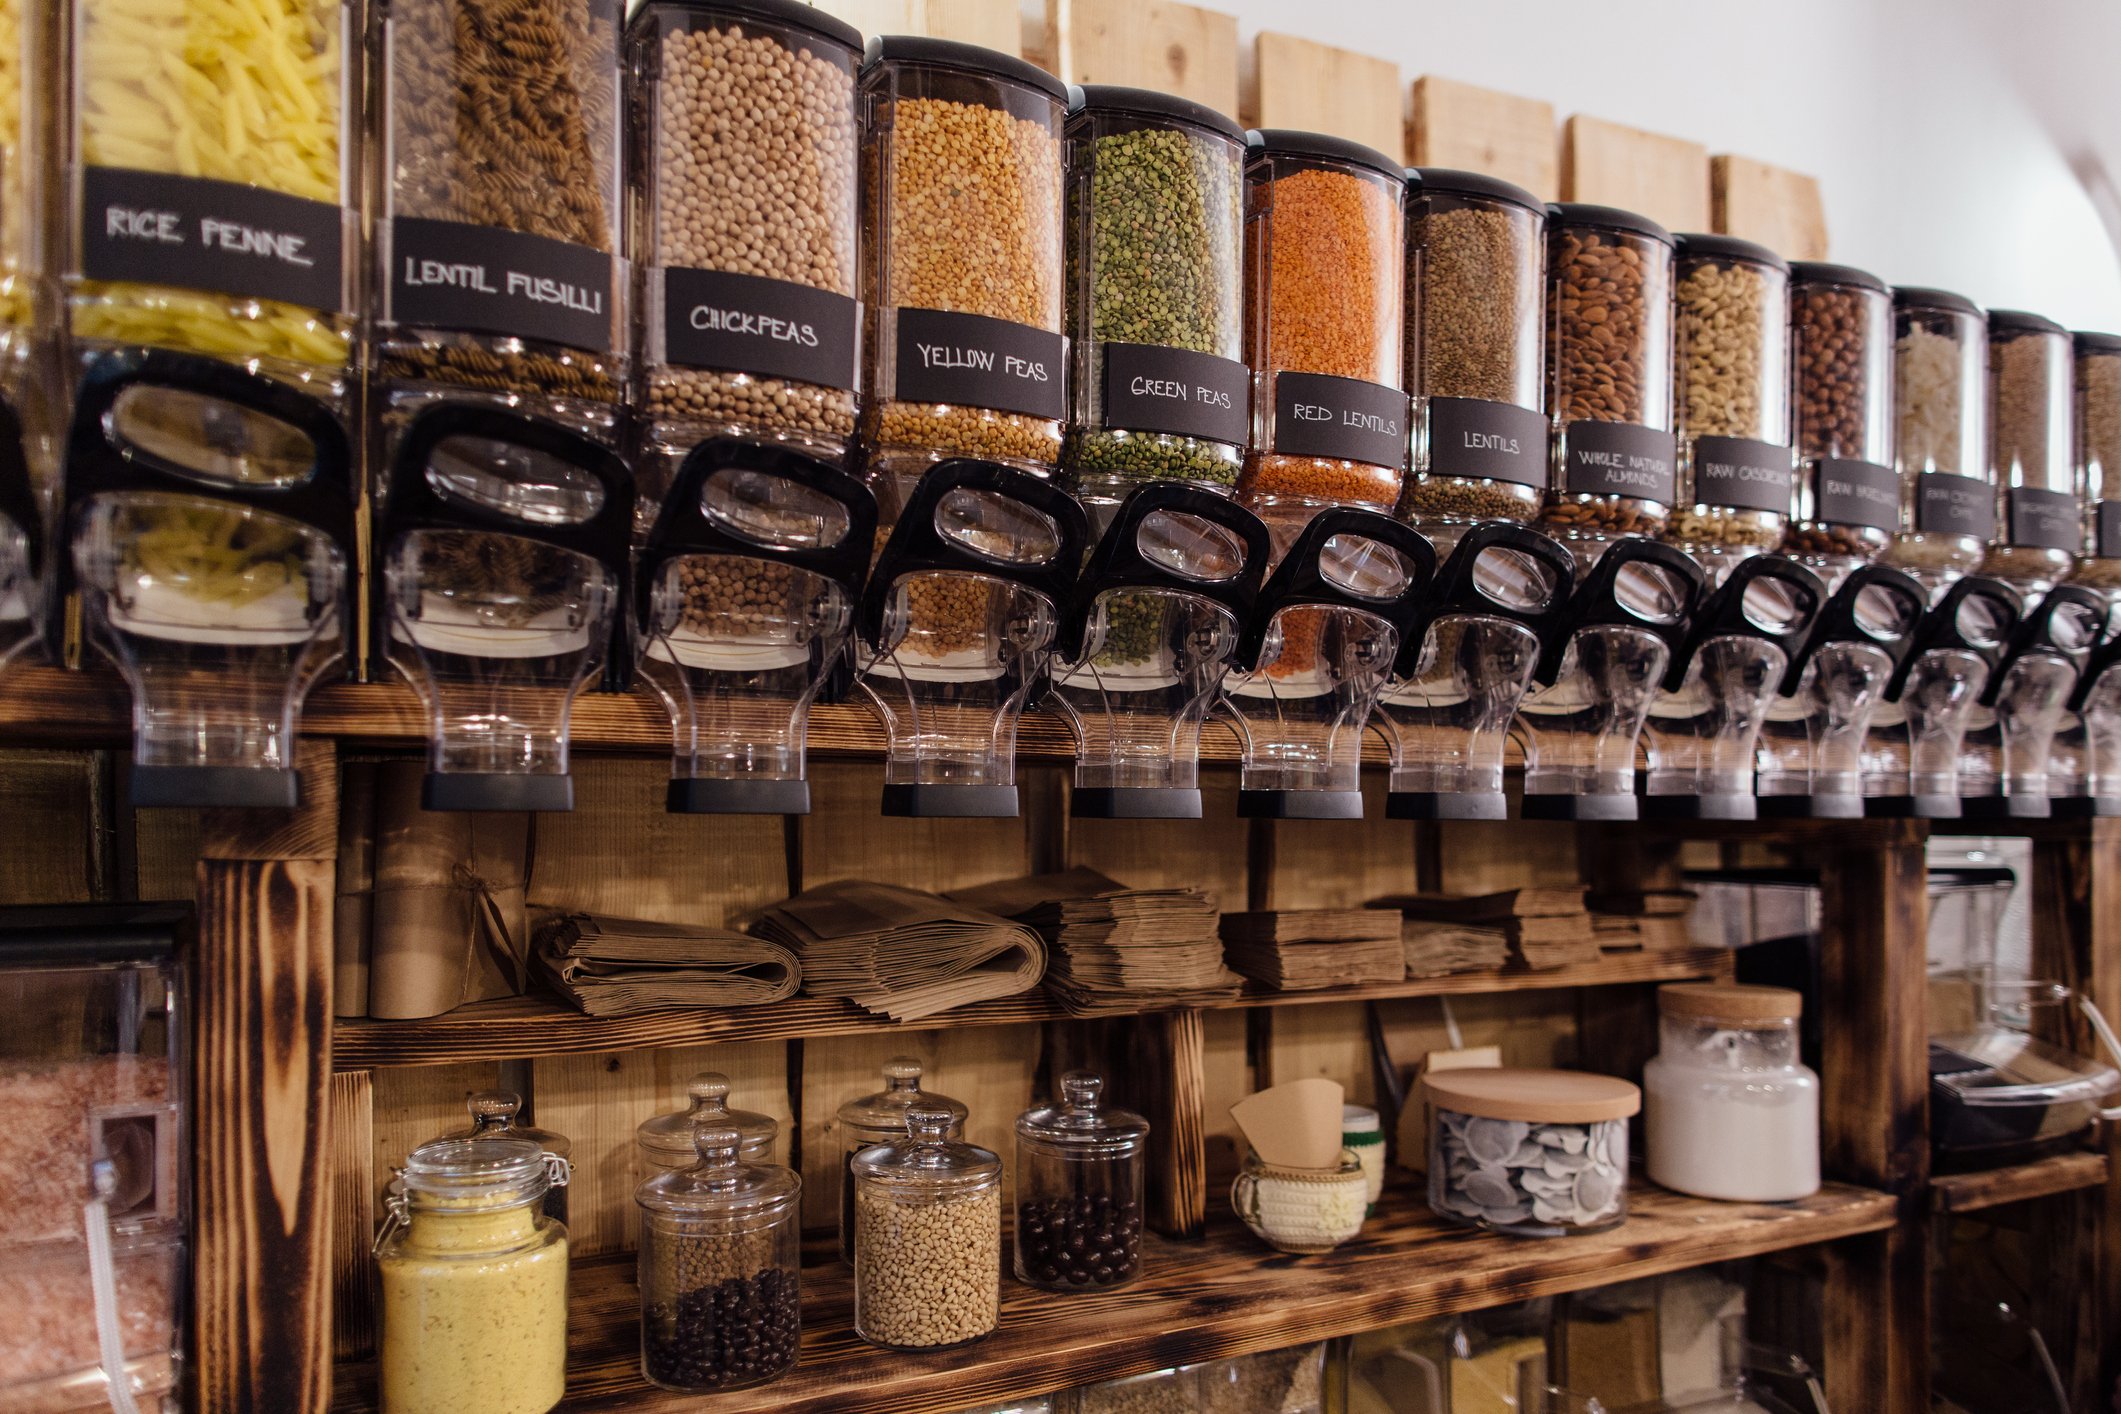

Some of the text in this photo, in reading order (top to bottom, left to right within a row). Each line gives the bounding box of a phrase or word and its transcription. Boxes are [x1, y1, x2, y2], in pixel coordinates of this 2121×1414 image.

[107, 207, 314, 265] RICE PENNE
[405, 257, 601, 314] LENTIL FUSILLI
[690, 304, 819, 347] CHICKPEAS
[916, 342, 1048, 382] YELLOW PEAS
[1130, 376, 1231, 410] GREEN PEAS
[1293, 403, 1398, 436] RED LENTILS
[1464, 431, 1520, 455] LENTILS
[1578, 450, 1625, 469] WHOLE
[1605, 468, 1659, 489] ALMONDS
[1706, 462, 1735, 479] RAW
